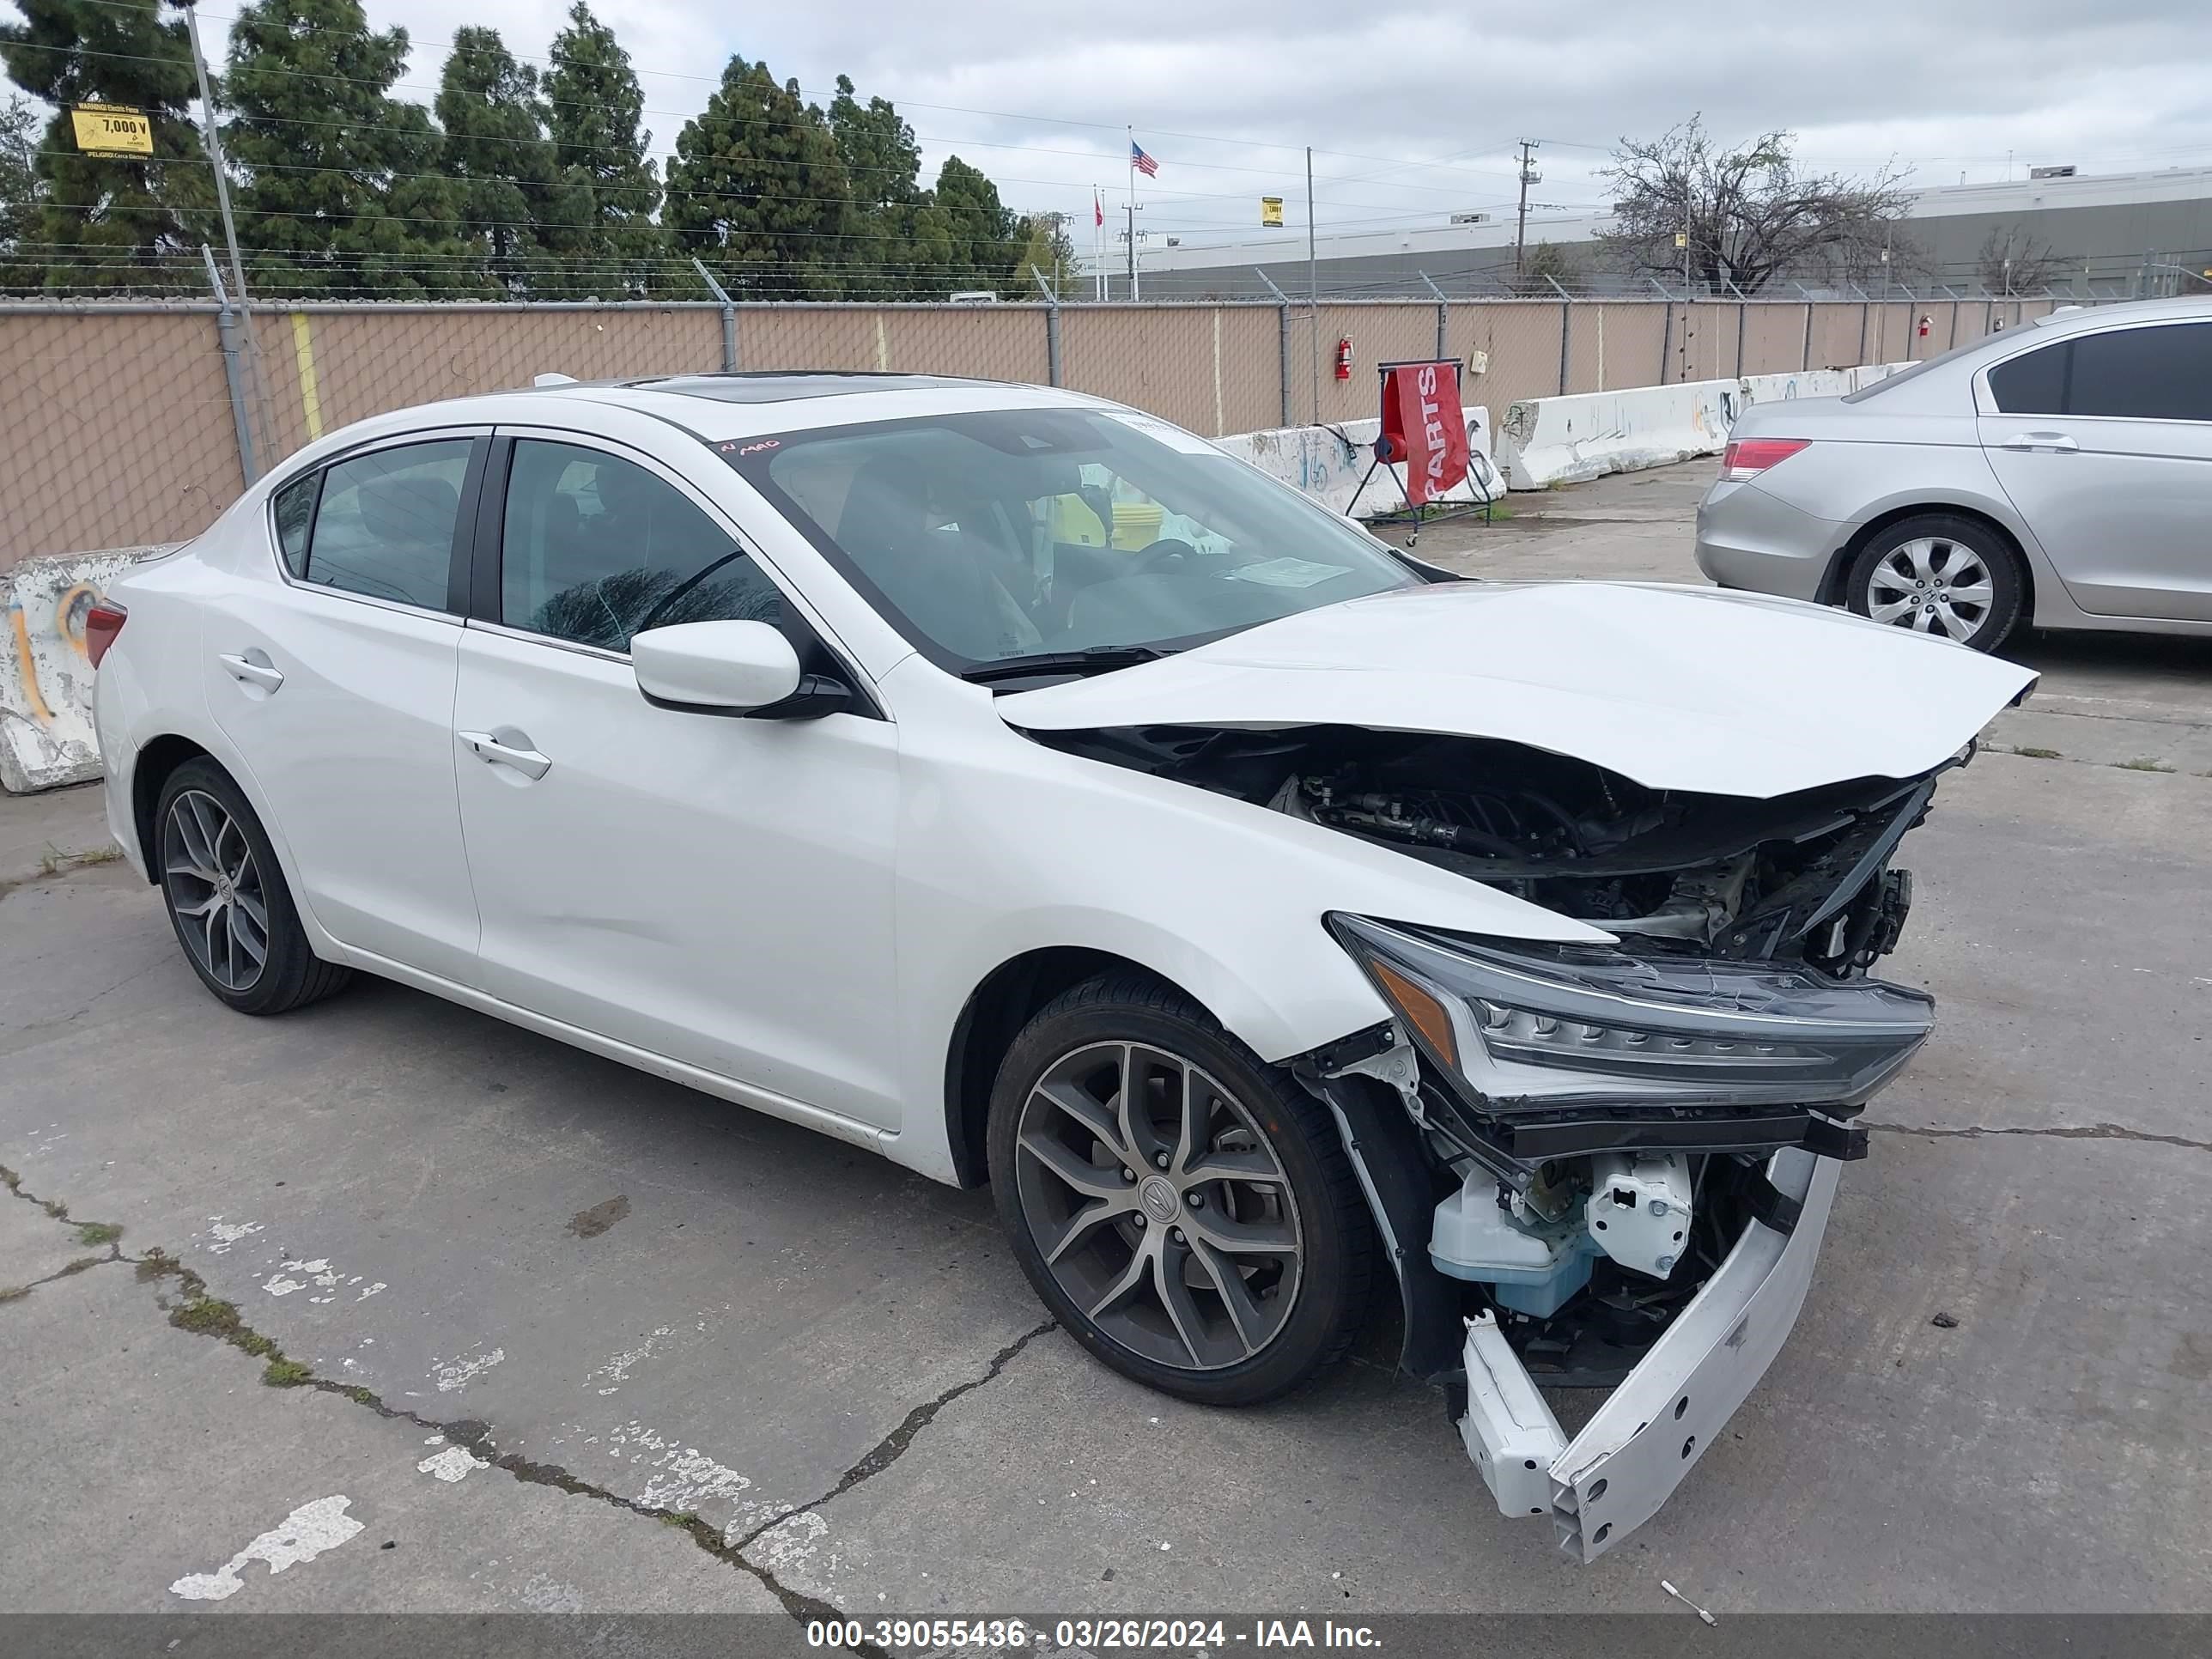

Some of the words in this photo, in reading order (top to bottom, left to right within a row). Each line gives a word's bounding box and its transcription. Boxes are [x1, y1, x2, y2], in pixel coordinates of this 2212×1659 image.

[77, 102, 107, 111] WARNING!
[103, 119, 137, 134] 7,000
[138, 122, 146, 134] V
[1418, 366, 1448, 502] PARTS
